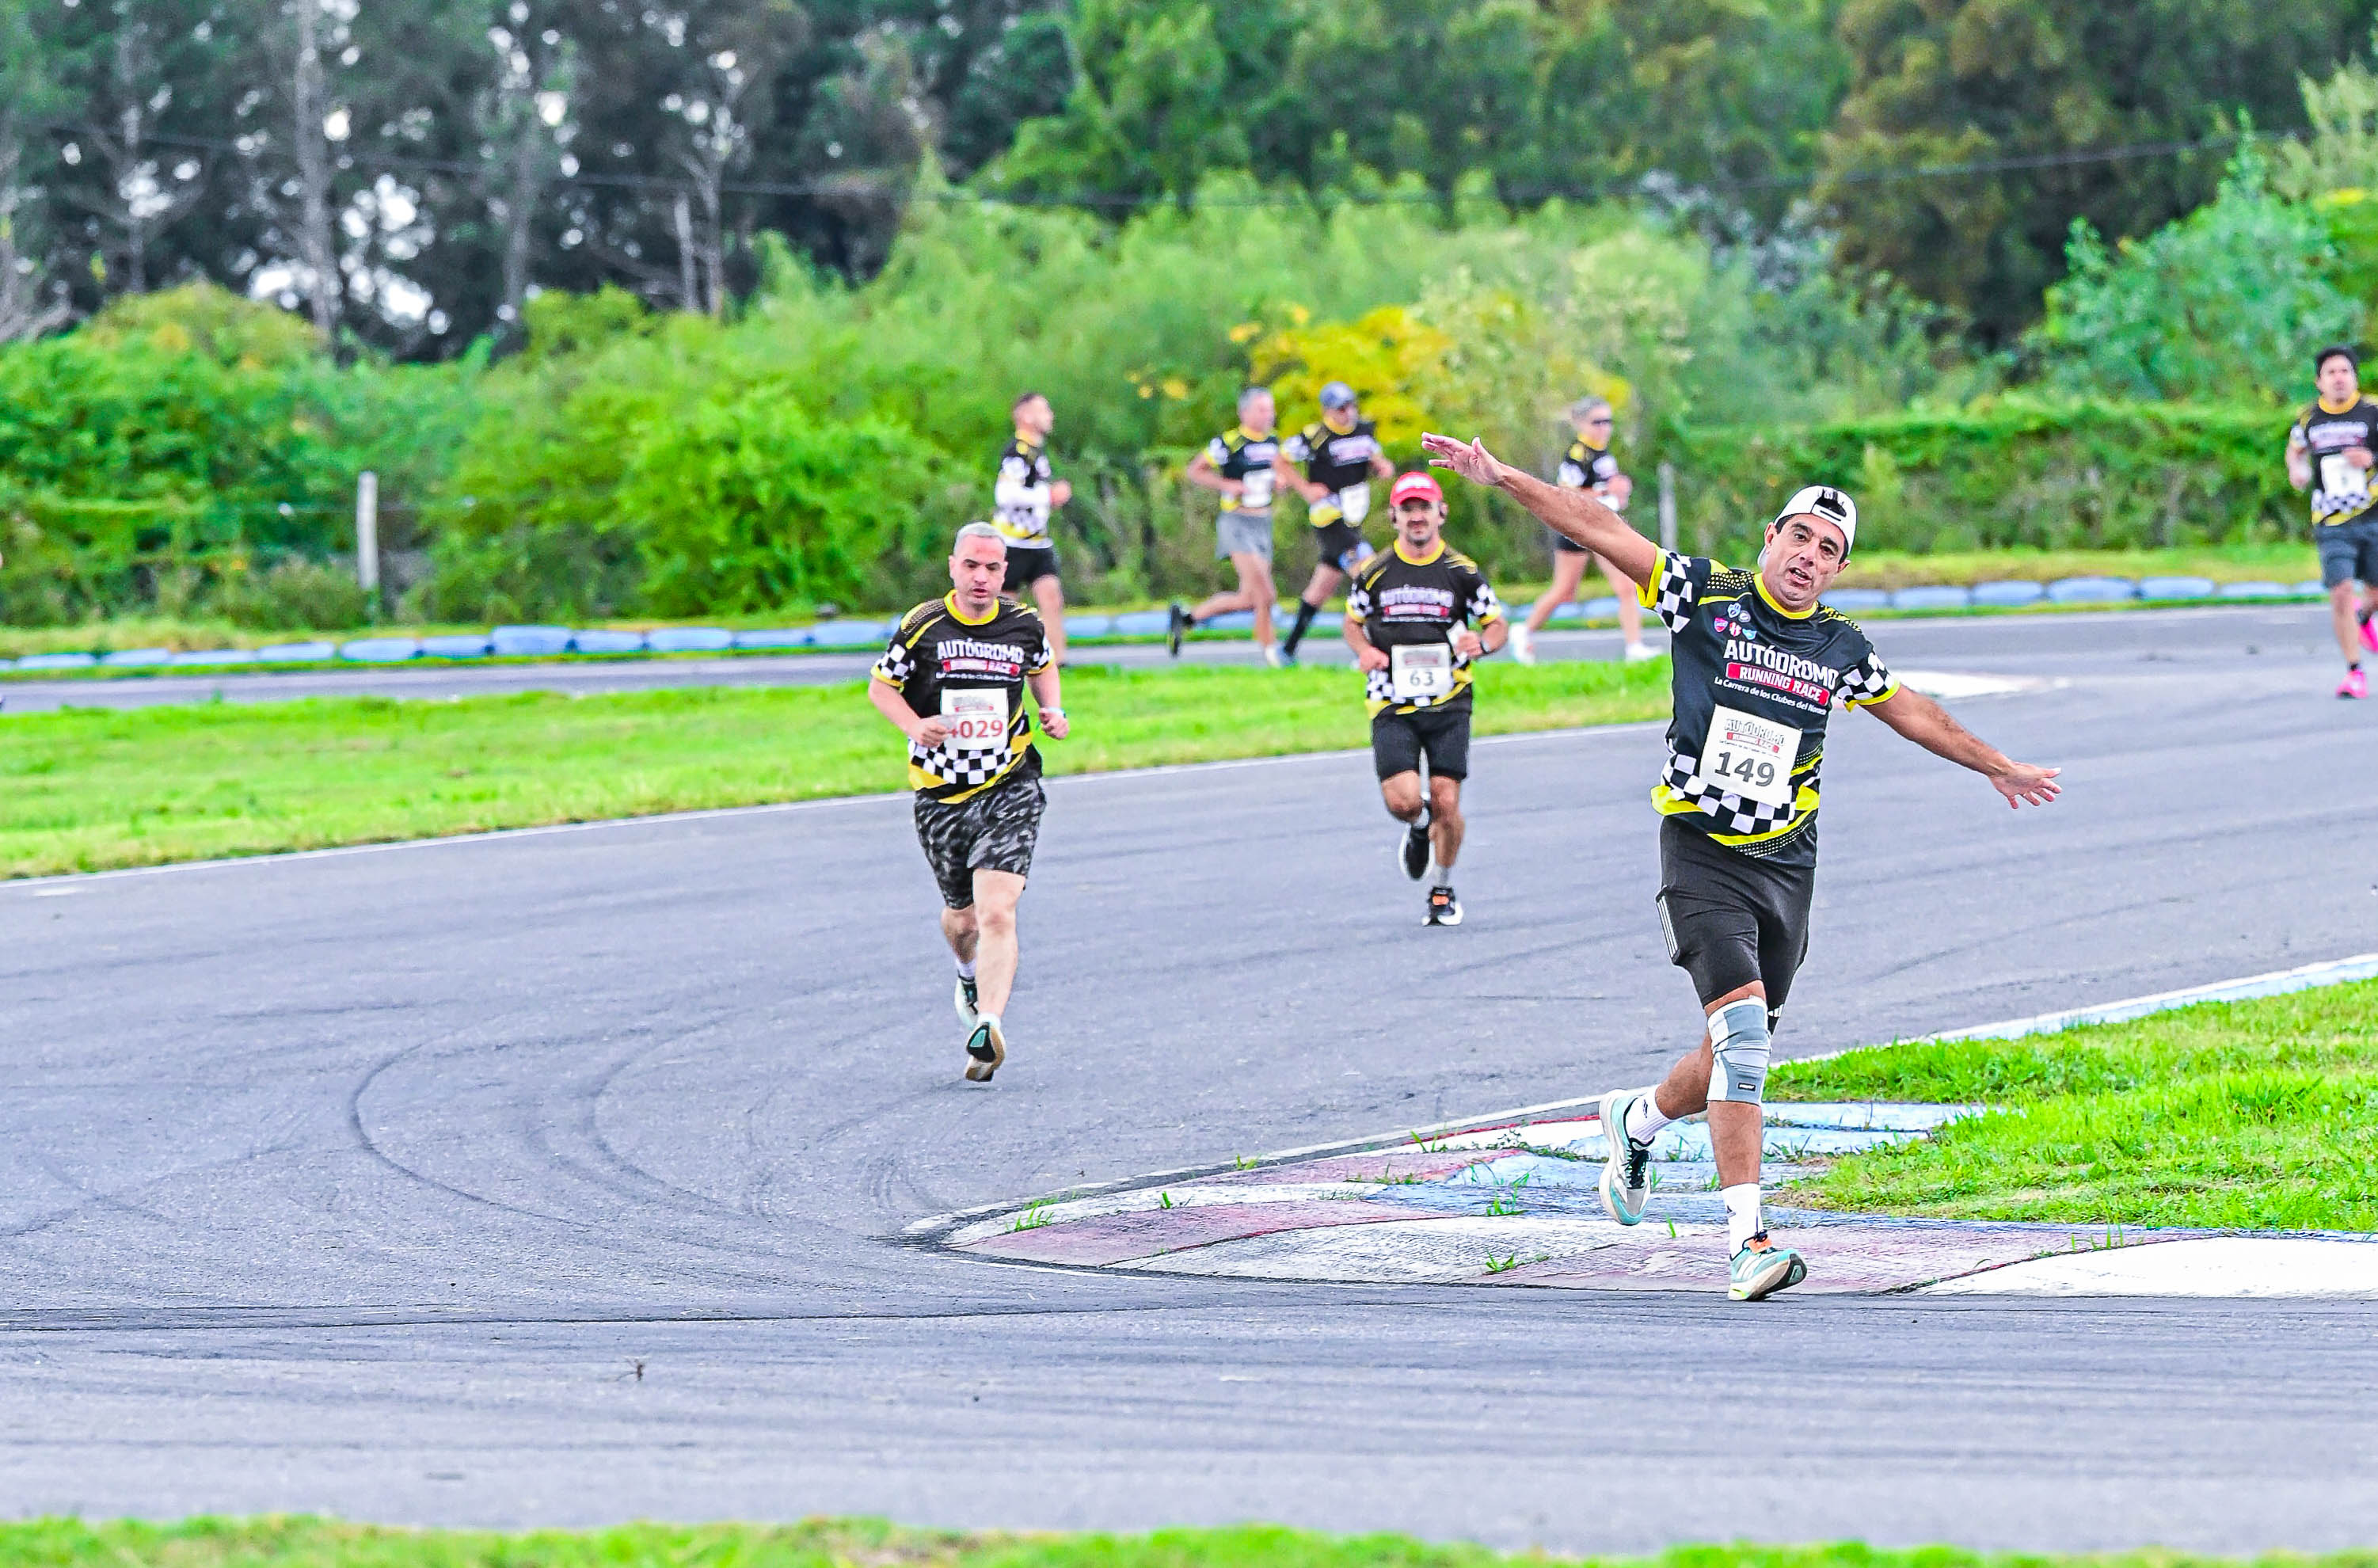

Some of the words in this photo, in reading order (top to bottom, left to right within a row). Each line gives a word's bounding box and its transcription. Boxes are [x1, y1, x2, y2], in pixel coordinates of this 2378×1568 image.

[937, 637, 1025, 664] AUTÓDROMO
[1723, 639, 1840, 691] AUTÓDROMO
[1410, 671, 1434, 687] 63
[1714, 676, 1722, 686] La
[1723, 679, 1749, 693] Carrera
[1750, 687, 1760, 696] de
[1760, 689, 1771, 699] los
[1771, 693, 1796, 706] Clubes
[1796, 700, 1808, 710] del
[1740, 666, 1791, 690] RUNNING
[1793, 679, 1823, 702] RACE
[1714, 752, 1775, 787] 149
